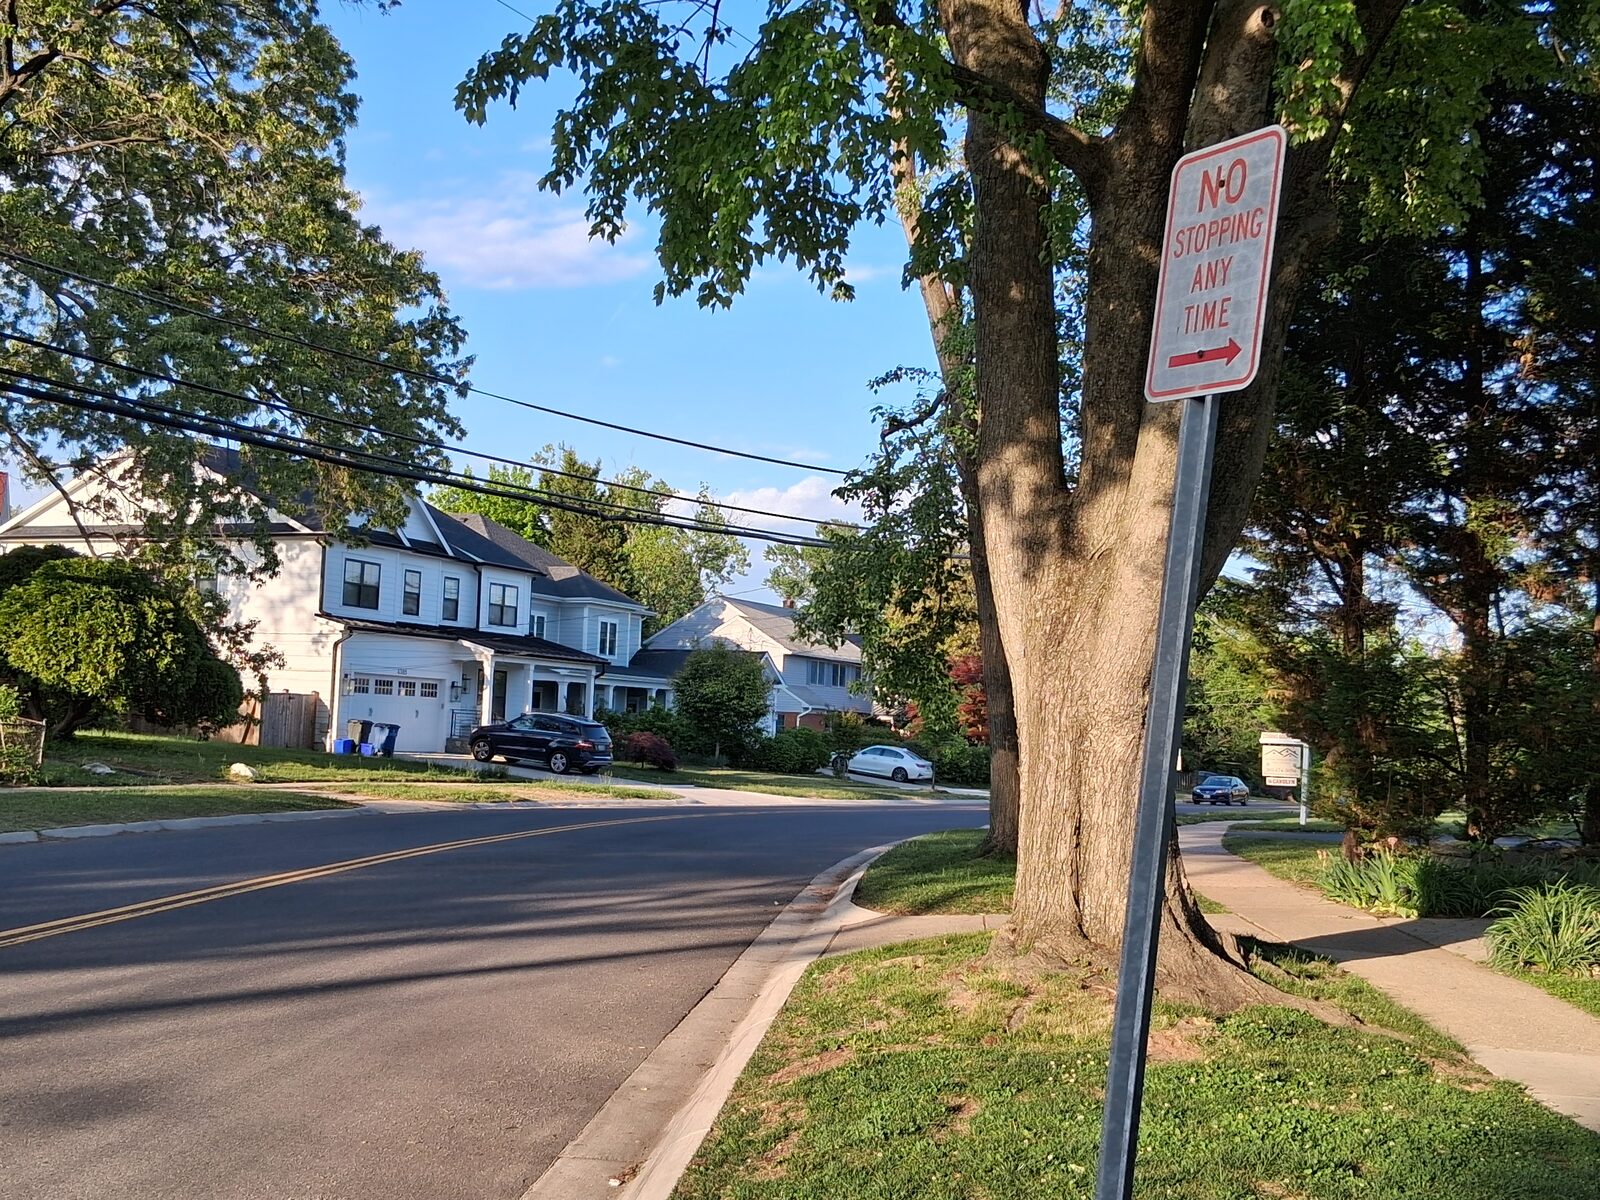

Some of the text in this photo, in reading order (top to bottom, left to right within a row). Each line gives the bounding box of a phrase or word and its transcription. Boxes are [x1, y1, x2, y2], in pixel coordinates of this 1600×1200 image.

[1197, 158, 1247, 213] NO
[1173, 207, 1264, 258] STOPPING
[1190, 255, 1234, 293] ANY
[1184, 297, 1232, 335] TIME
